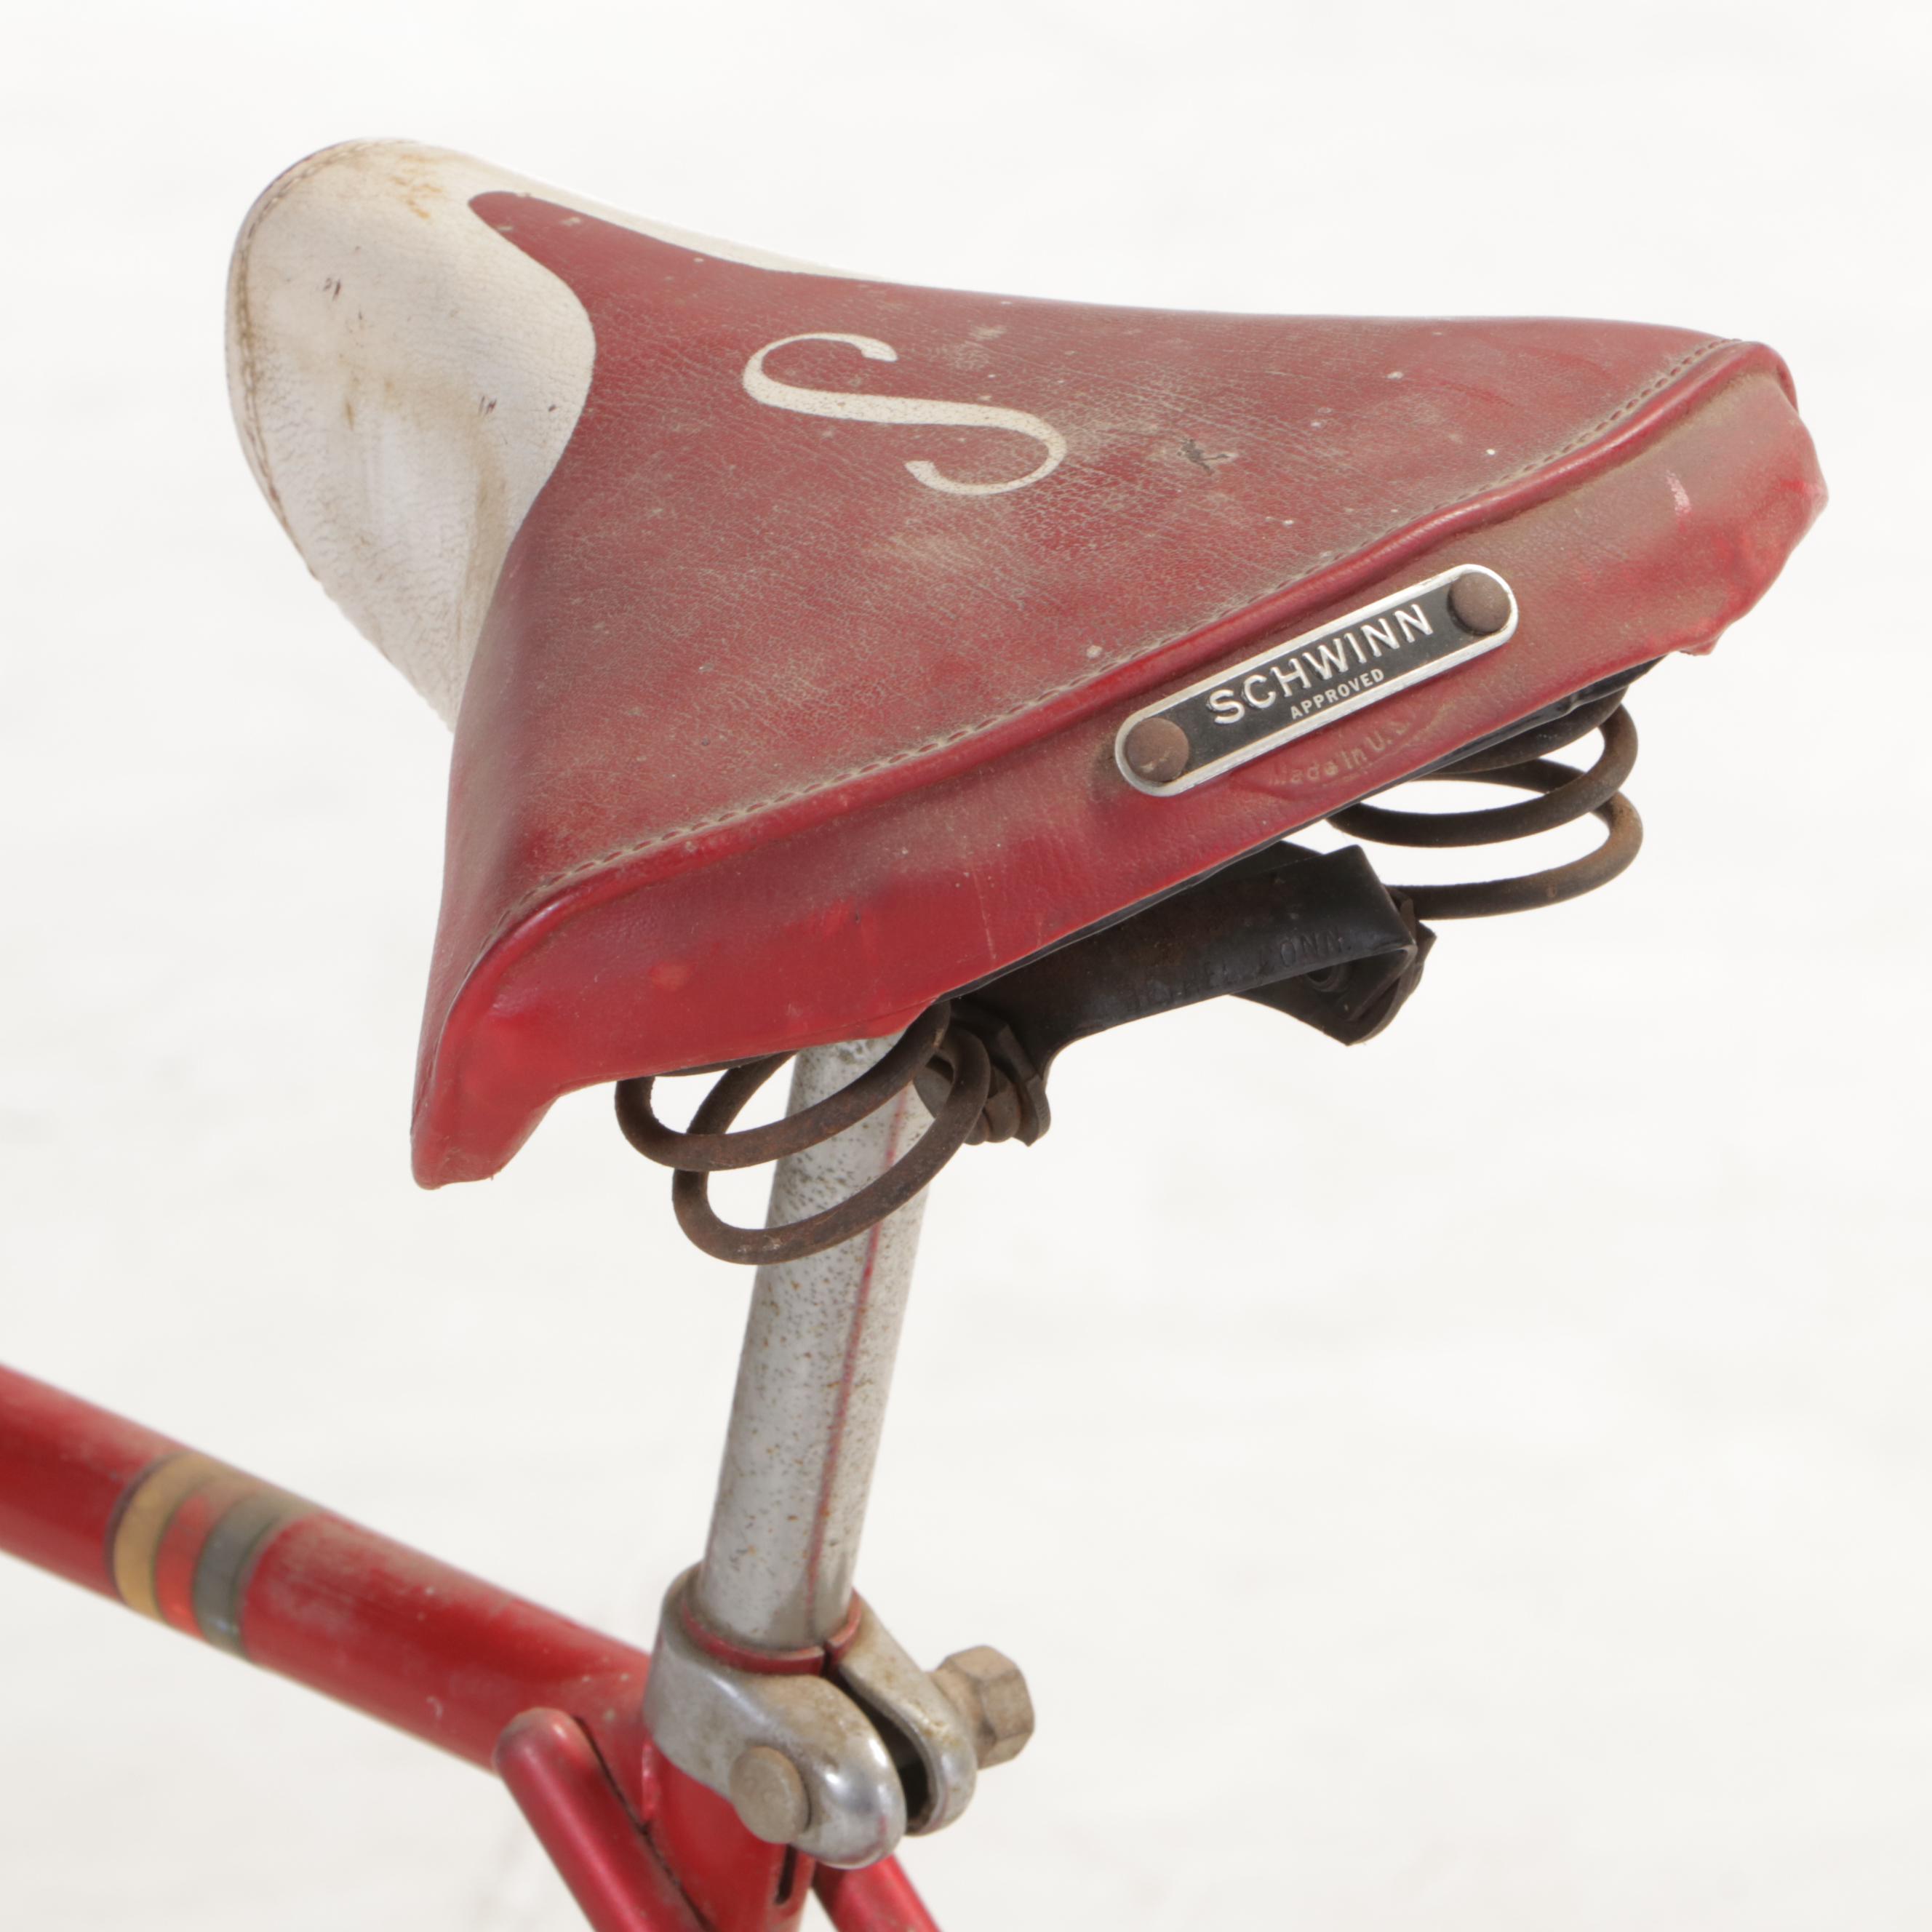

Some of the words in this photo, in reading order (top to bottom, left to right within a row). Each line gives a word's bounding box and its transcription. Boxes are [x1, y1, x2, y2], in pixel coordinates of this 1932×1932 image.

[743, 332, 1067, 495] S
[1206, 604, 1434, 724] SCHWINN
[1290, 668, 1384, 719] APPROVED
